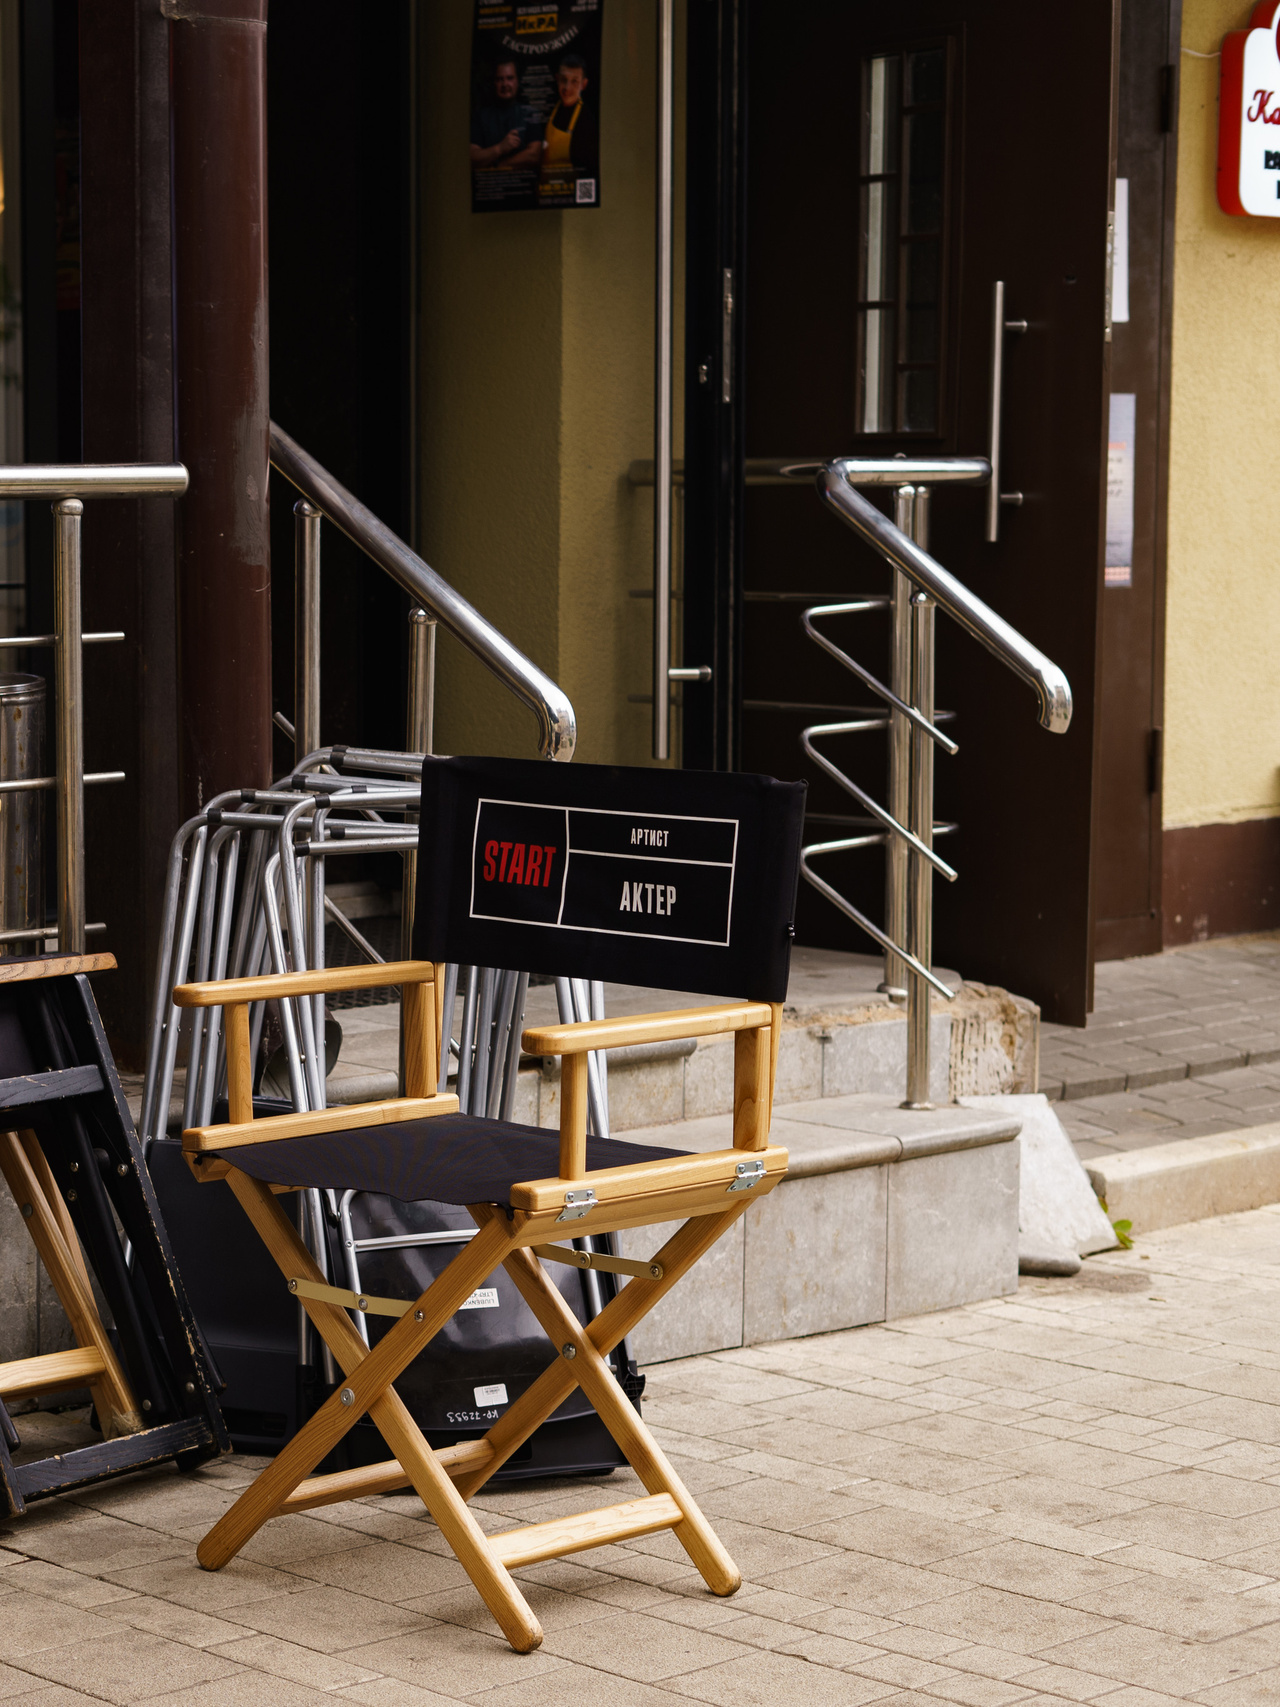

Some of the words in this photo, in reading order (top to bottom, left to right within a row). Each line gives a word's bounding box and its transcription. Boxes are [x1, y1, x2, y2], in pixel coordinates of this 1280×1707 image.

[630, 827, 669, 848] АРТИСТ
[482, 839, 557, 888] START
[619, 880, 677, 916] АКТЕР
